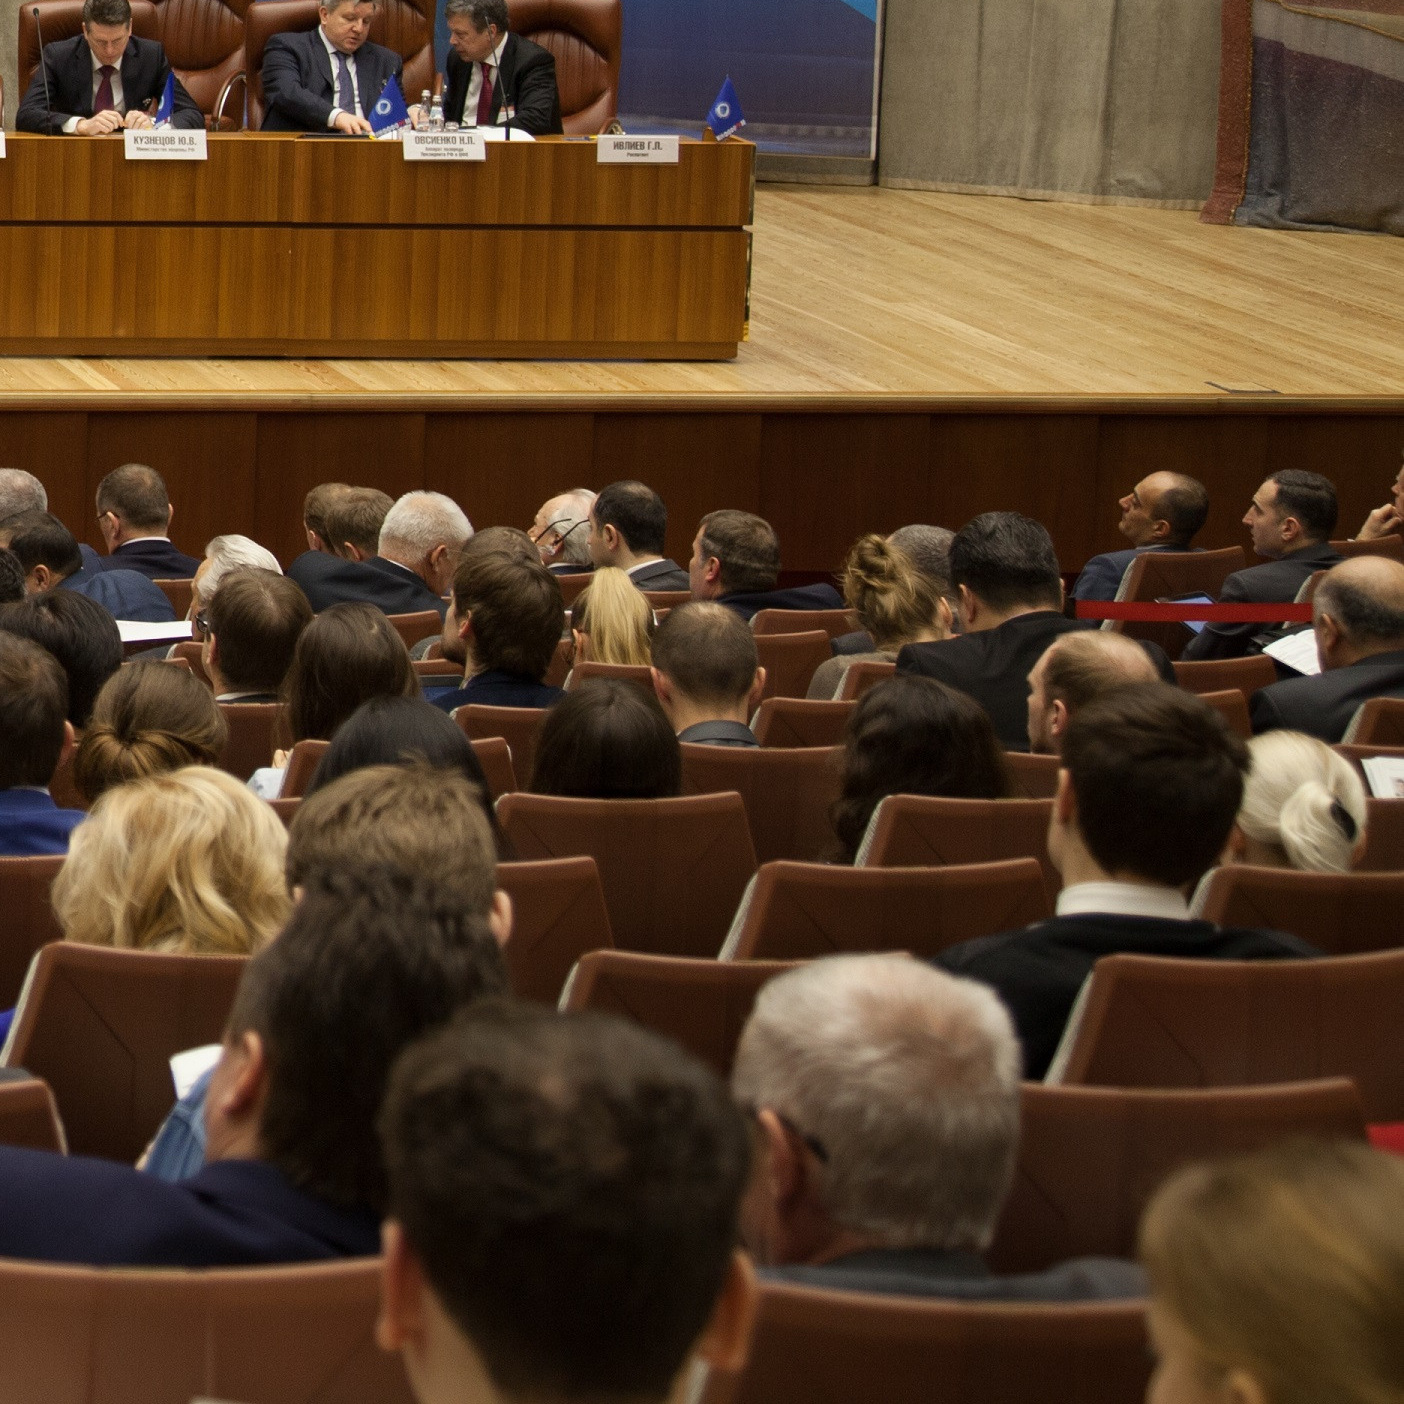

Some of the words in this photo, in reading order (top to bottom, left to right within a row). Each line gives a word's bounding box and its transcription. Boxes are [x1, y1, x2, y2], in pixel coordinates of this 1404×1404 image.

[133, 136, 175, 146] КУЗНЕЦОВ
[178, 136, 197, 145] Ю.В.
[414, 136, 457, 145] ОВСИЕНКО
[459, 136, 476, 145] Н.П.
[613, 141, 645, 150] ИВЛИЕВ
[648, 141, 663, 150] Г.П.
